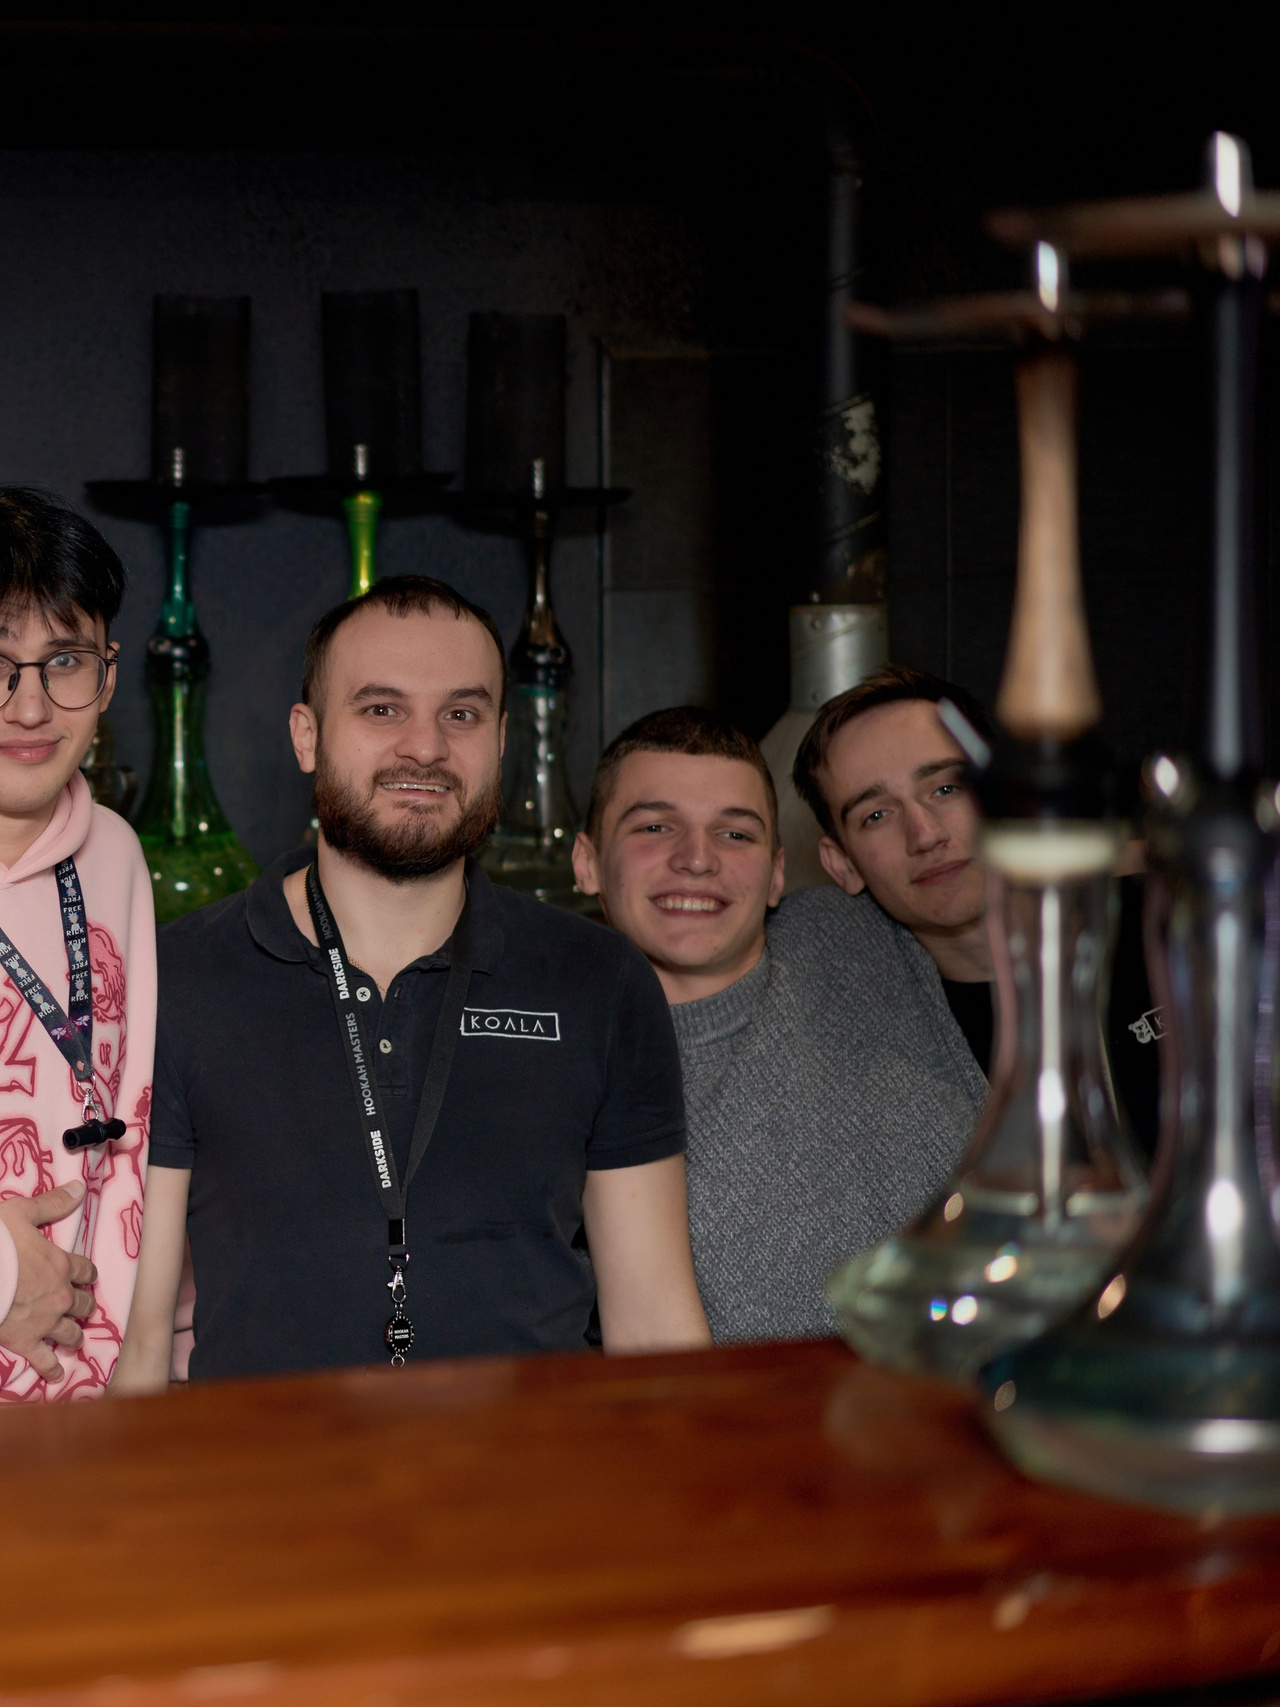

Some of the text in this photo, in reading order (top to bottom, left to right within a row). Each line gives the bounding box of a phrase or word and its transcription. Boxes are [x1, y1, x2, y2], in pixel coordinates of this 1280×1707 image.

[63, 904, 82, 913] FREE
[66, 927, 85, 936] RICK
[4, 953, 20, 967] RICK
[18, 973, 36, 988] FREE
[71, 970, 89, 980] FREE
[328, 947, 350, 1000] DARKSIDE
[24, 983, 42, 998] FREE
[71, 993, 89, 1002] RICK
[38, 1003, 57, 1018] RICK
[470, 1014, 545, 1034] KOALA
[345, 1012, 376, 1116] HOOKAH MASTERS
[370, 1129, 392, 1189] DARKSIDE
